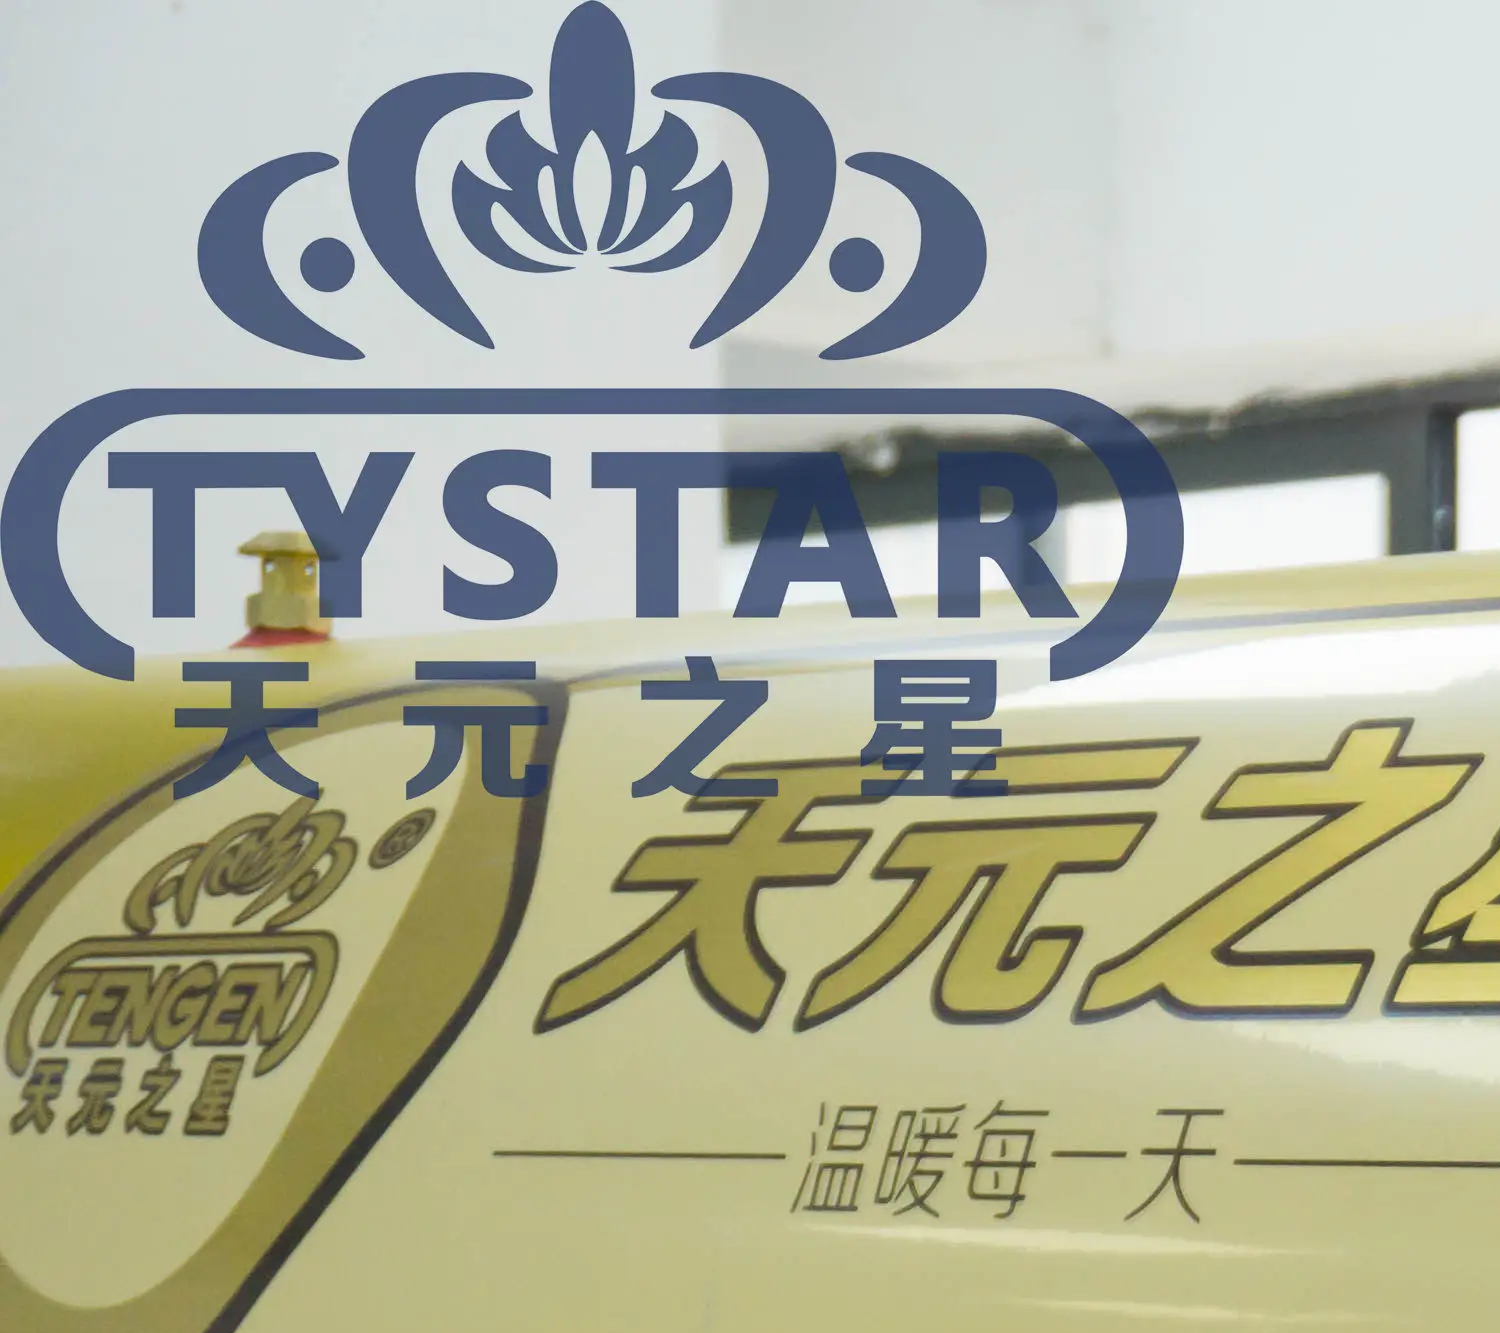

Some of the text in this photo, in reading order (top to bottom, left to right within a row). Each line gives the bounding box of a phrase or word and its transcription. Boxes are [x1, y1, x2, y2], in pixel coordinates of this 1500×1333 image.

[38, 961, 309, 1050] TENGEN
[9, 1053, 245, 1136] 天元之星
[789, 1099, 1225, 1224] 温暖每一天
